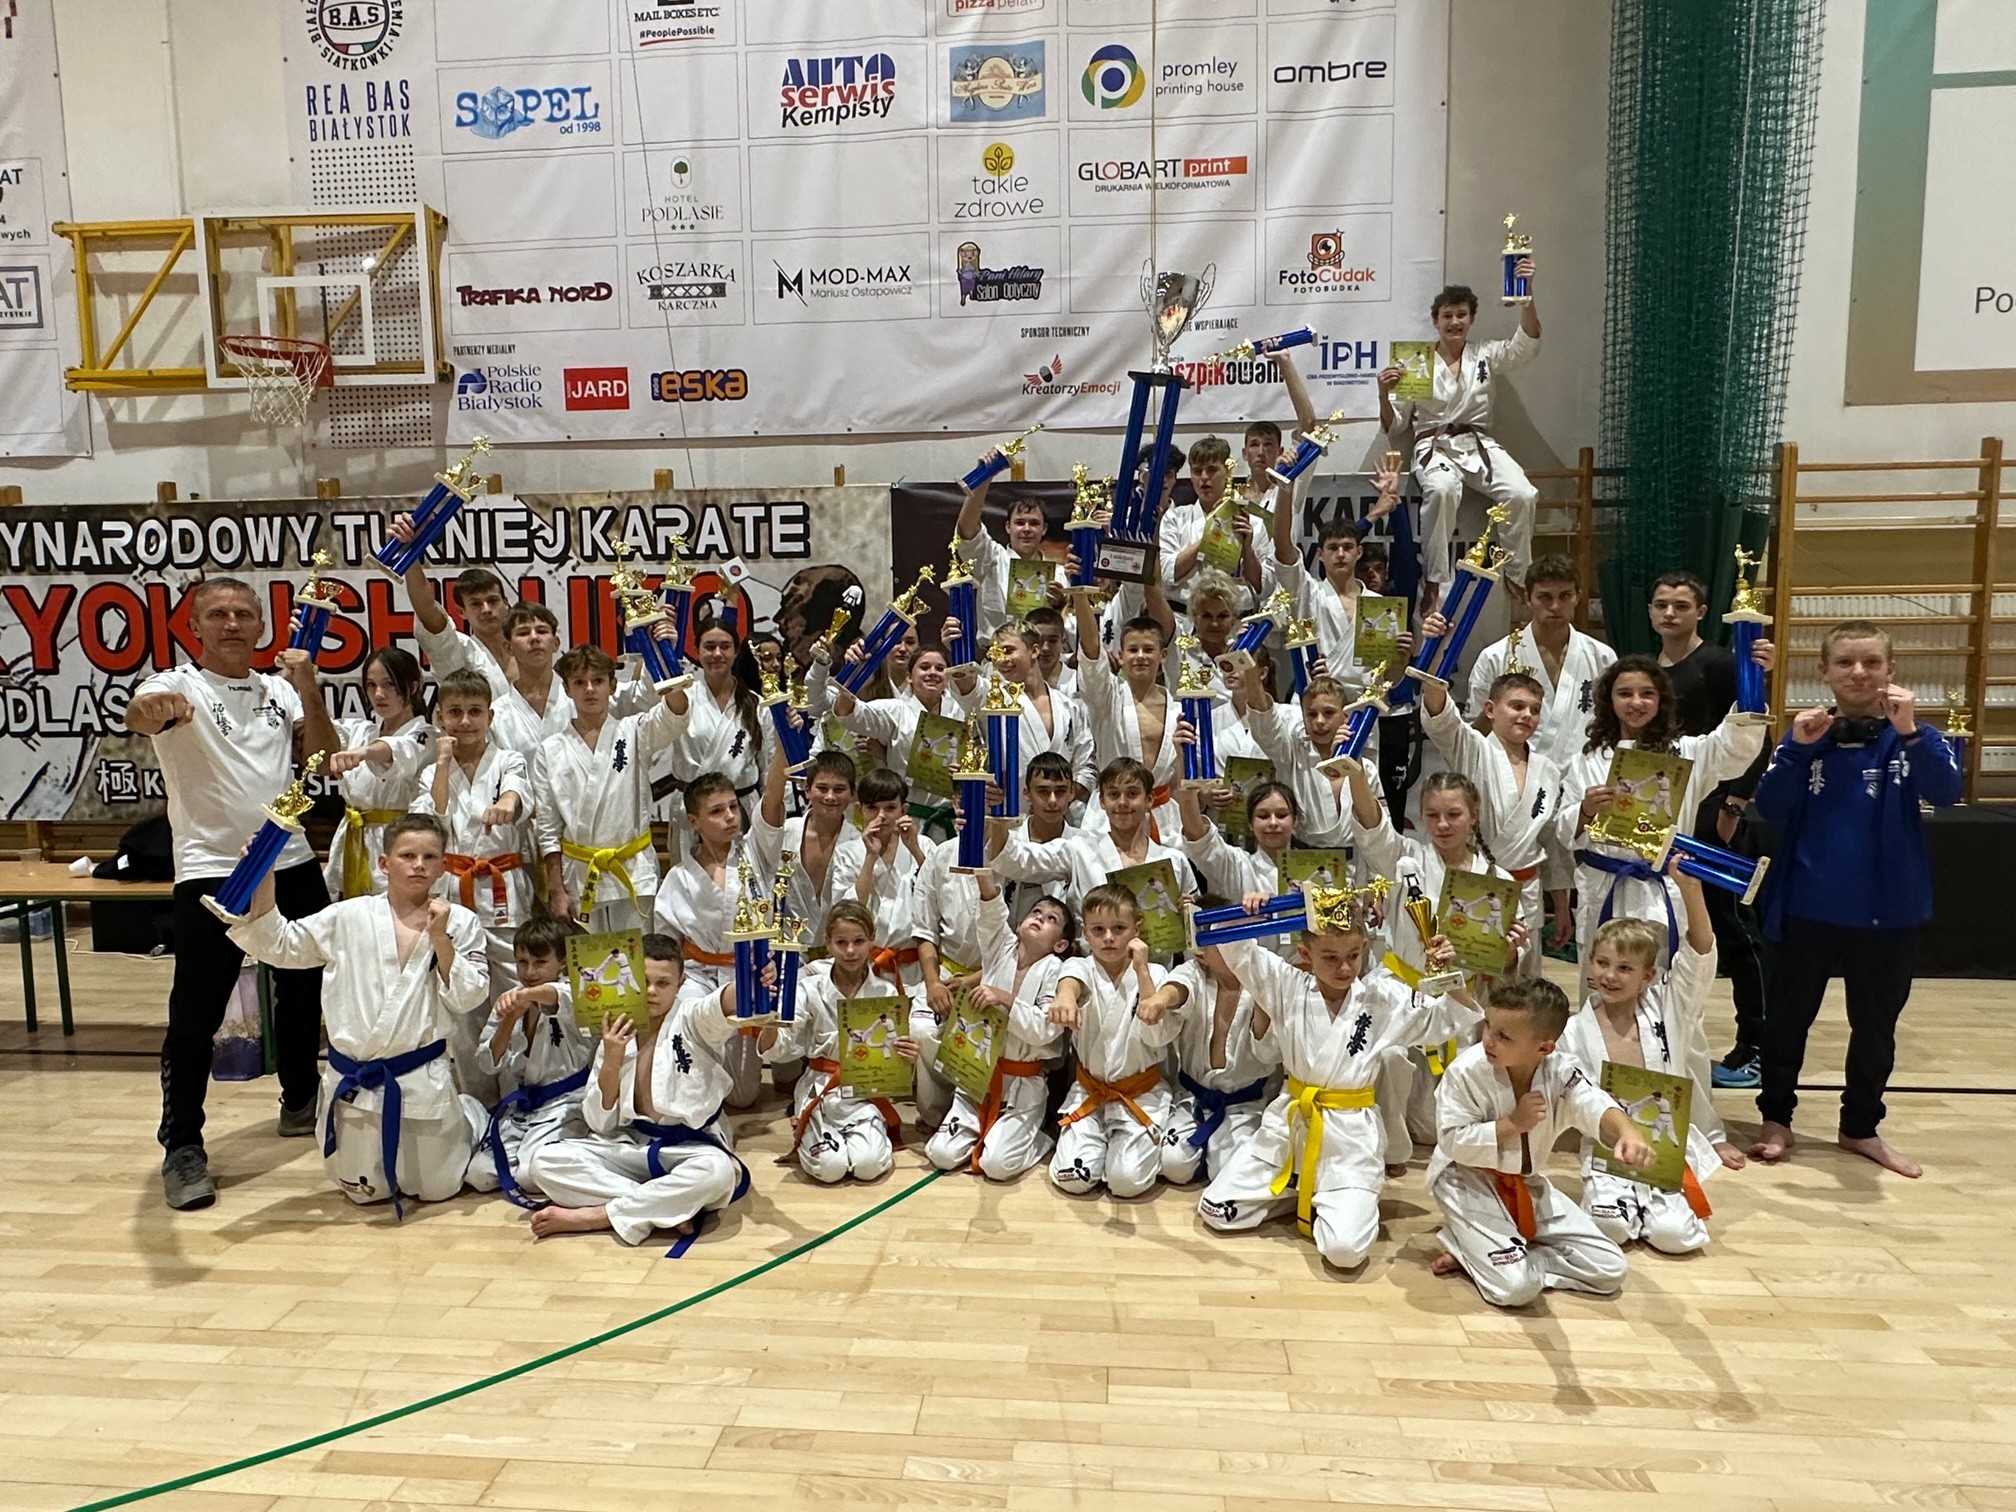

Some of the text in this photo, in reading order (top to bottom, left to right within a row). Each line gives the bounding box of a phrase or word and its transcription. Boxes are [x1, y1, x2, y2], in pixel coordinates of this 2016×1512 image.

[634, 11, 662, 22] MAIL
[664, 8, 696, 19] BOXES
[955, 0, 995, 12] pizza
[328, 5, 379, 27] B.A.S
[640, 25, 715, 39] #PeoplePossible
[781, 52, 896, 90] AUTO
[1162, 56, 1238, 80] promley
[1274, 60, 1387, 84] ombre
[306, 79, 410, 116] REA BAS
[780, 76, 896, 109] serwis
[1155, 80, 1244, 98] printing house
[781, 95, 895, 128] Kempisty
[309, 113, 411, 142] BIAŁYSTOK
[560, 121, 602, 134] od 1998
[1078, 158, 1231, 181] GLOBART print
[972, 173, 1029, 195] takie
[1095, 179, 1231, 193] DRUKARNIA WELKOFORMATOWA
[664, 195, 699, 203] HOTEL
[954, 197, 1044, 218] zdrowe
[641, 205, 724, 222] PODLASIE
[637, 262, 737, 285] KOSZARKA
[810, 265, 911, 285] MOD-MAX
[1279, 267, 1376, 286] FotoCudak
[810, 285, 913, 299] Mariusz Ostapowicz
[976, 284, 999, 300] Salon
[1293, 285, 1361, 294] FOTOBUDKA
[658, 299, 718, 311] KARCZMA
[1020, 326, 1090, 338] SPONSOR TECHNICZNY
[1194, 318, 1239, 331] WSPIERAJĄCE
[453, 345, 486, 356] PARTNERZY
[487, 363, 542, 378] Polskie
[489, 378, 543, 394] Radio
[571, 380, 628, 398] JARD
[1022, 381, 1121, 397] KreatorzyEmocji
[581, 504, 805, 558] KARATE
[97, 760, 138, 803] 極
